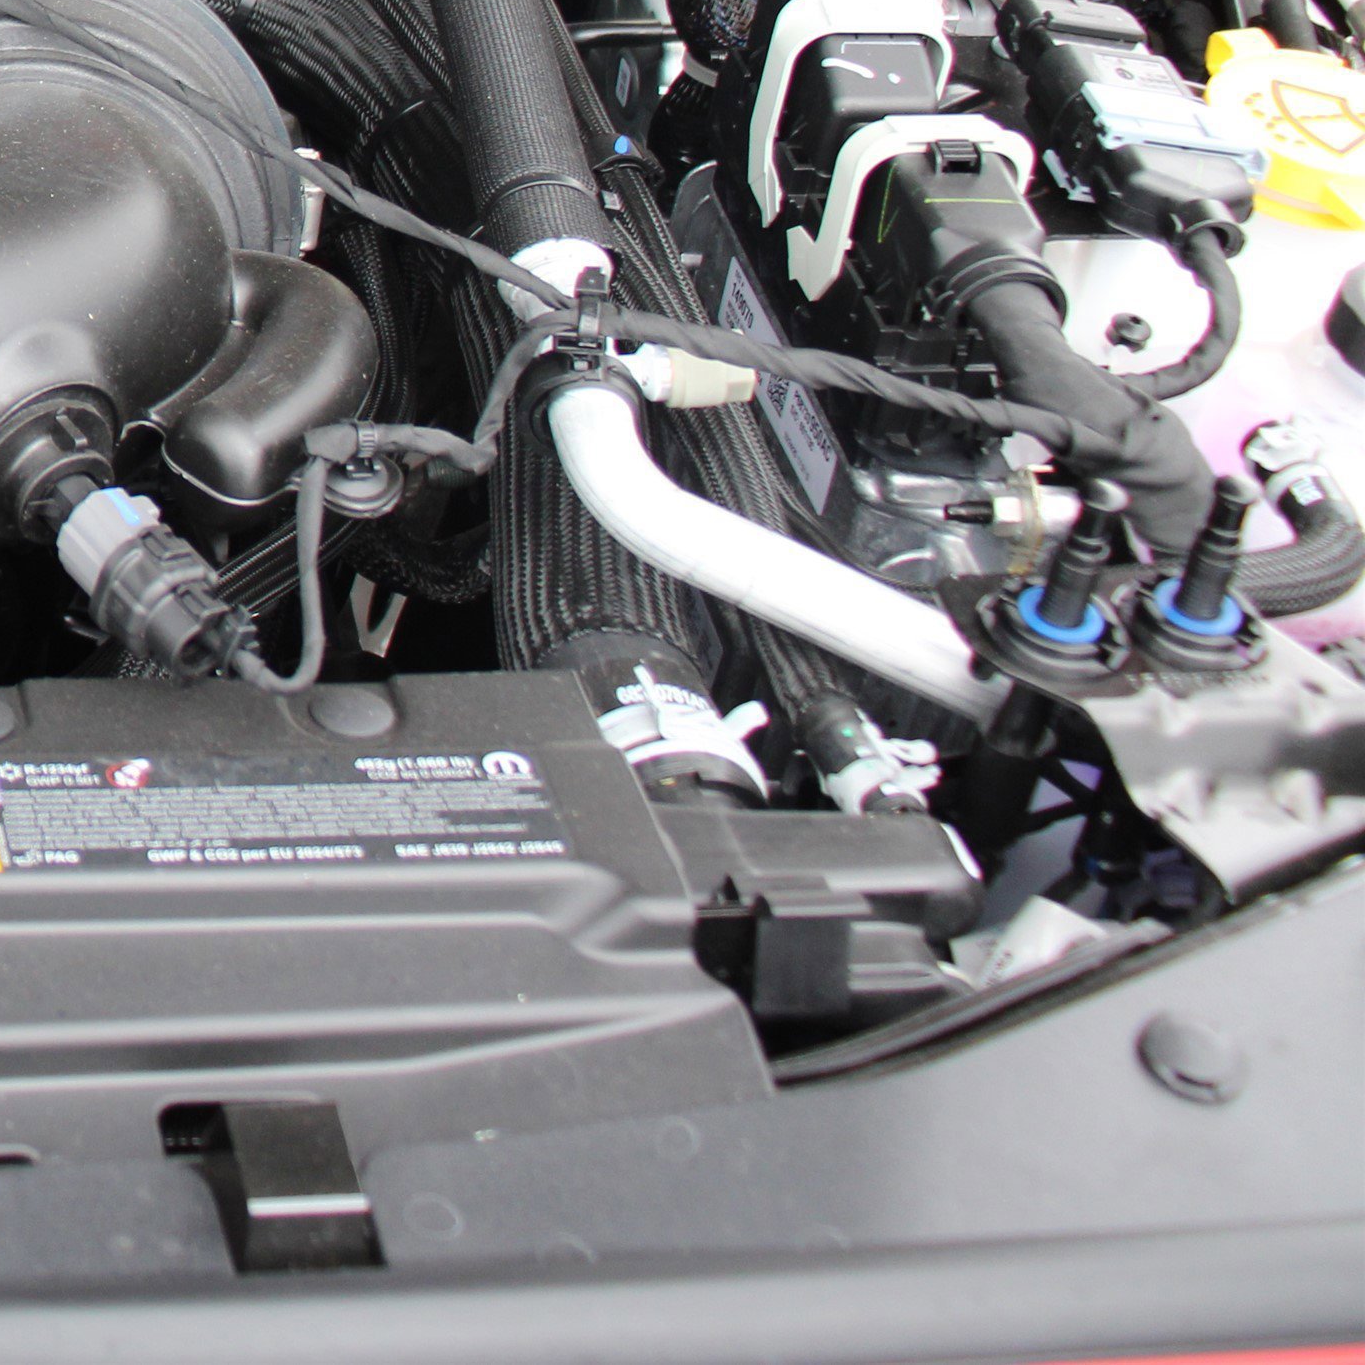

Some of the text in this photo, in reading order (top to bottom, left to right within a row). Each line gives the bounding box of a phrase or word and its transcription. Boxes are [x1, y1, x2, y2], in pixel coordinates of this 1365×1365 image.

[23, 762, 90, 776] R-1234yf
[147, 849, 187, 863] GWP
[204, 848, 240, 862] CO2
[269, 846, 294, 860] EU
[394, 843, 430, 858] SAE
